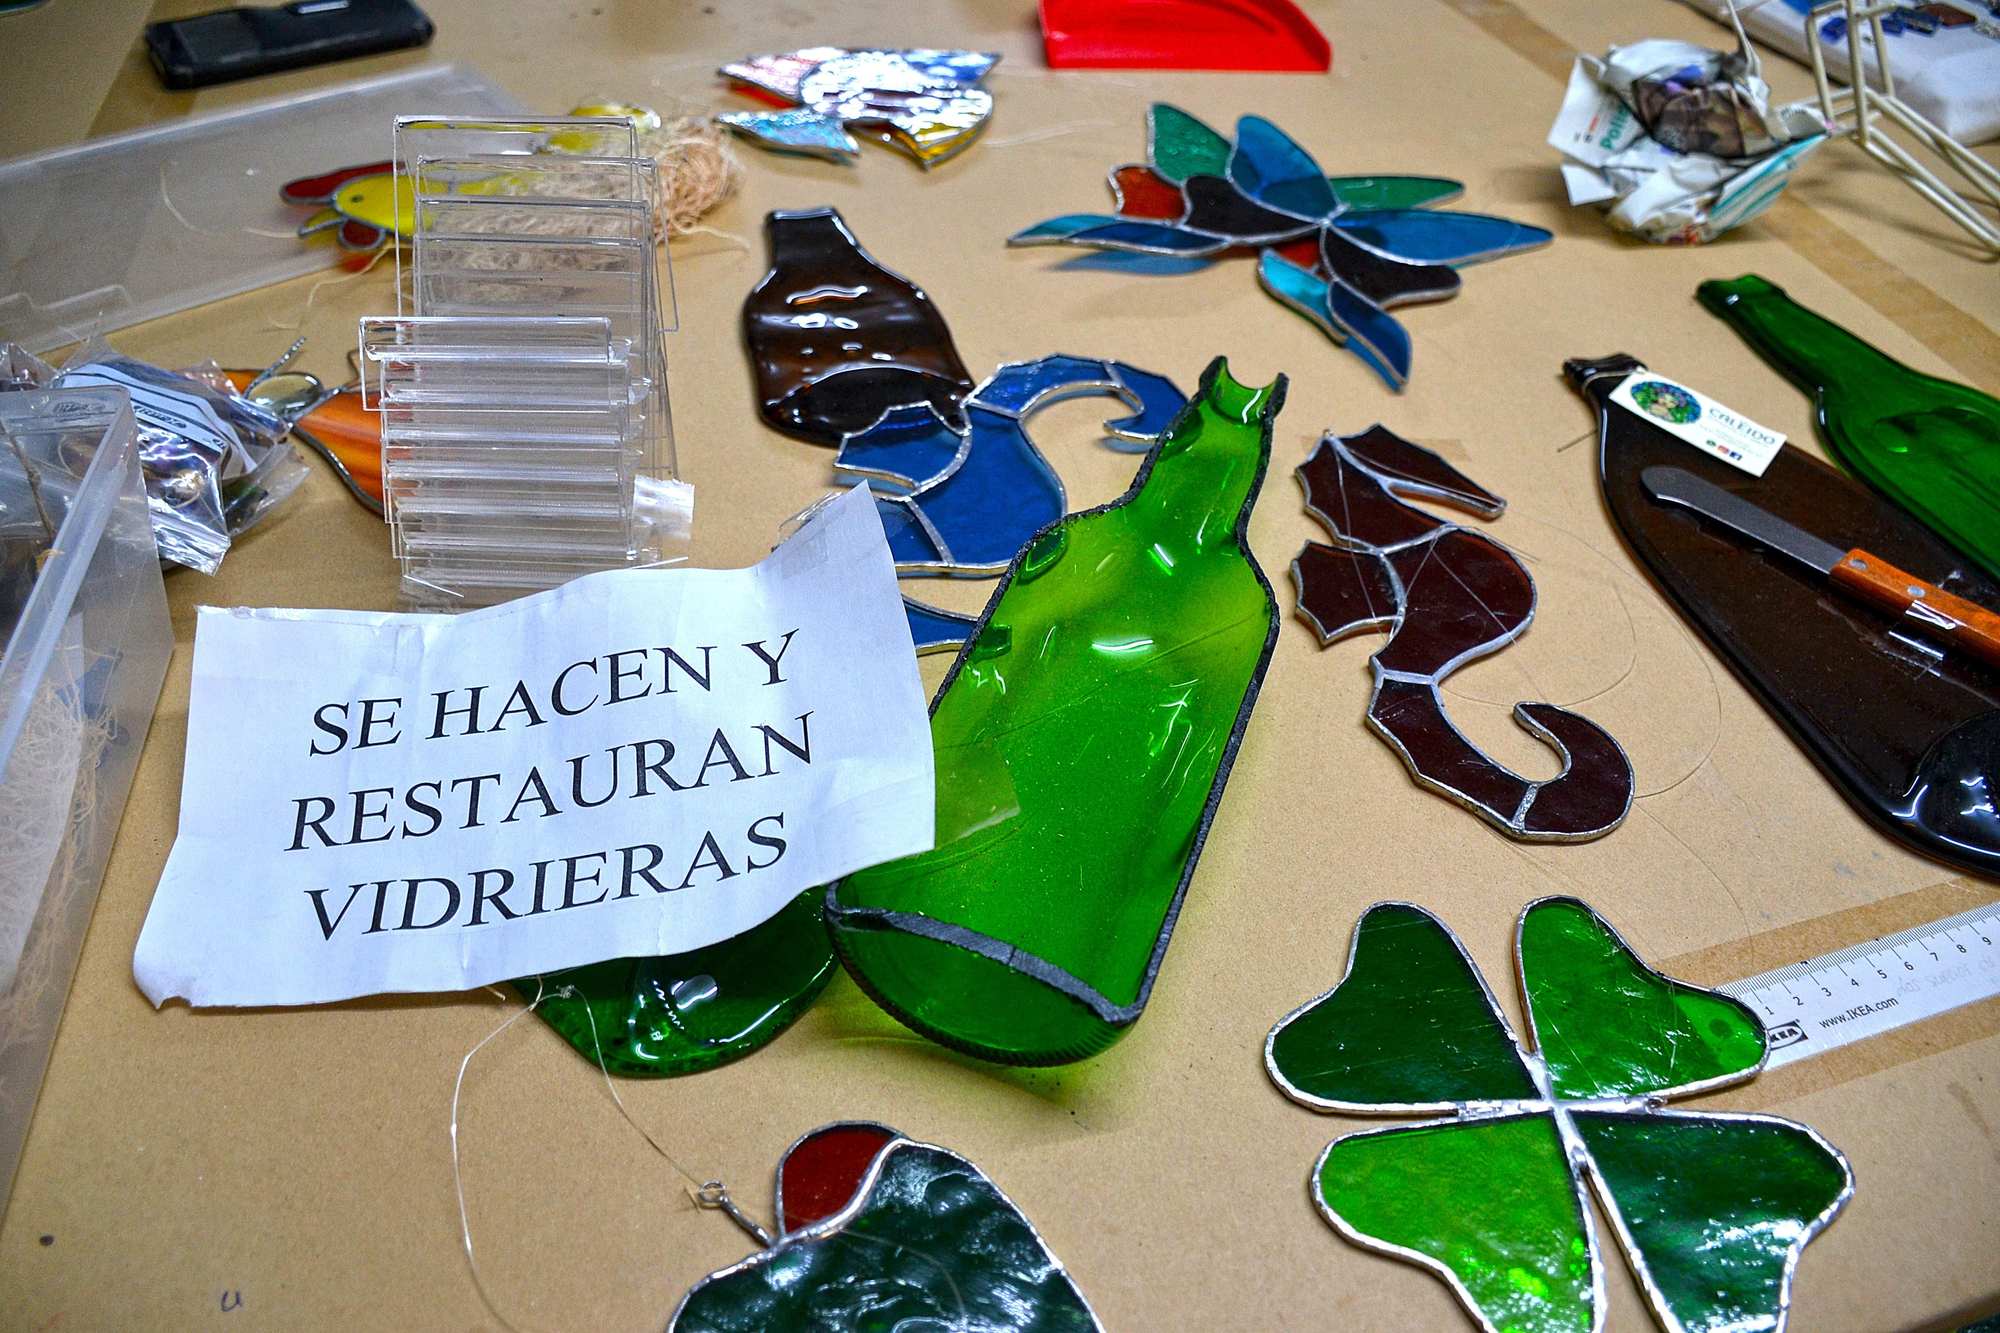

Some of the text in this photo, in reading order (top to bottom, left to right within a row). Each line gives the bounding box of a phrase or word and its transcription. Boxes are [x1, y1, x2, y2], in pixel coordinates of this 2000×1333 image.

[310, 628, 800, 757] SE HACEN Y
[283, 710, 815, 853] RESTAURAN
[304, 812, 787, 942] VIDRIERAS
[1765, 936, 1992, 1015] 1 2 3 4 5 6 7 8 9
[1819, 997, 1899, 1028] www.IKEA.com
[1771, 1028, 1799, 1043] KEA
